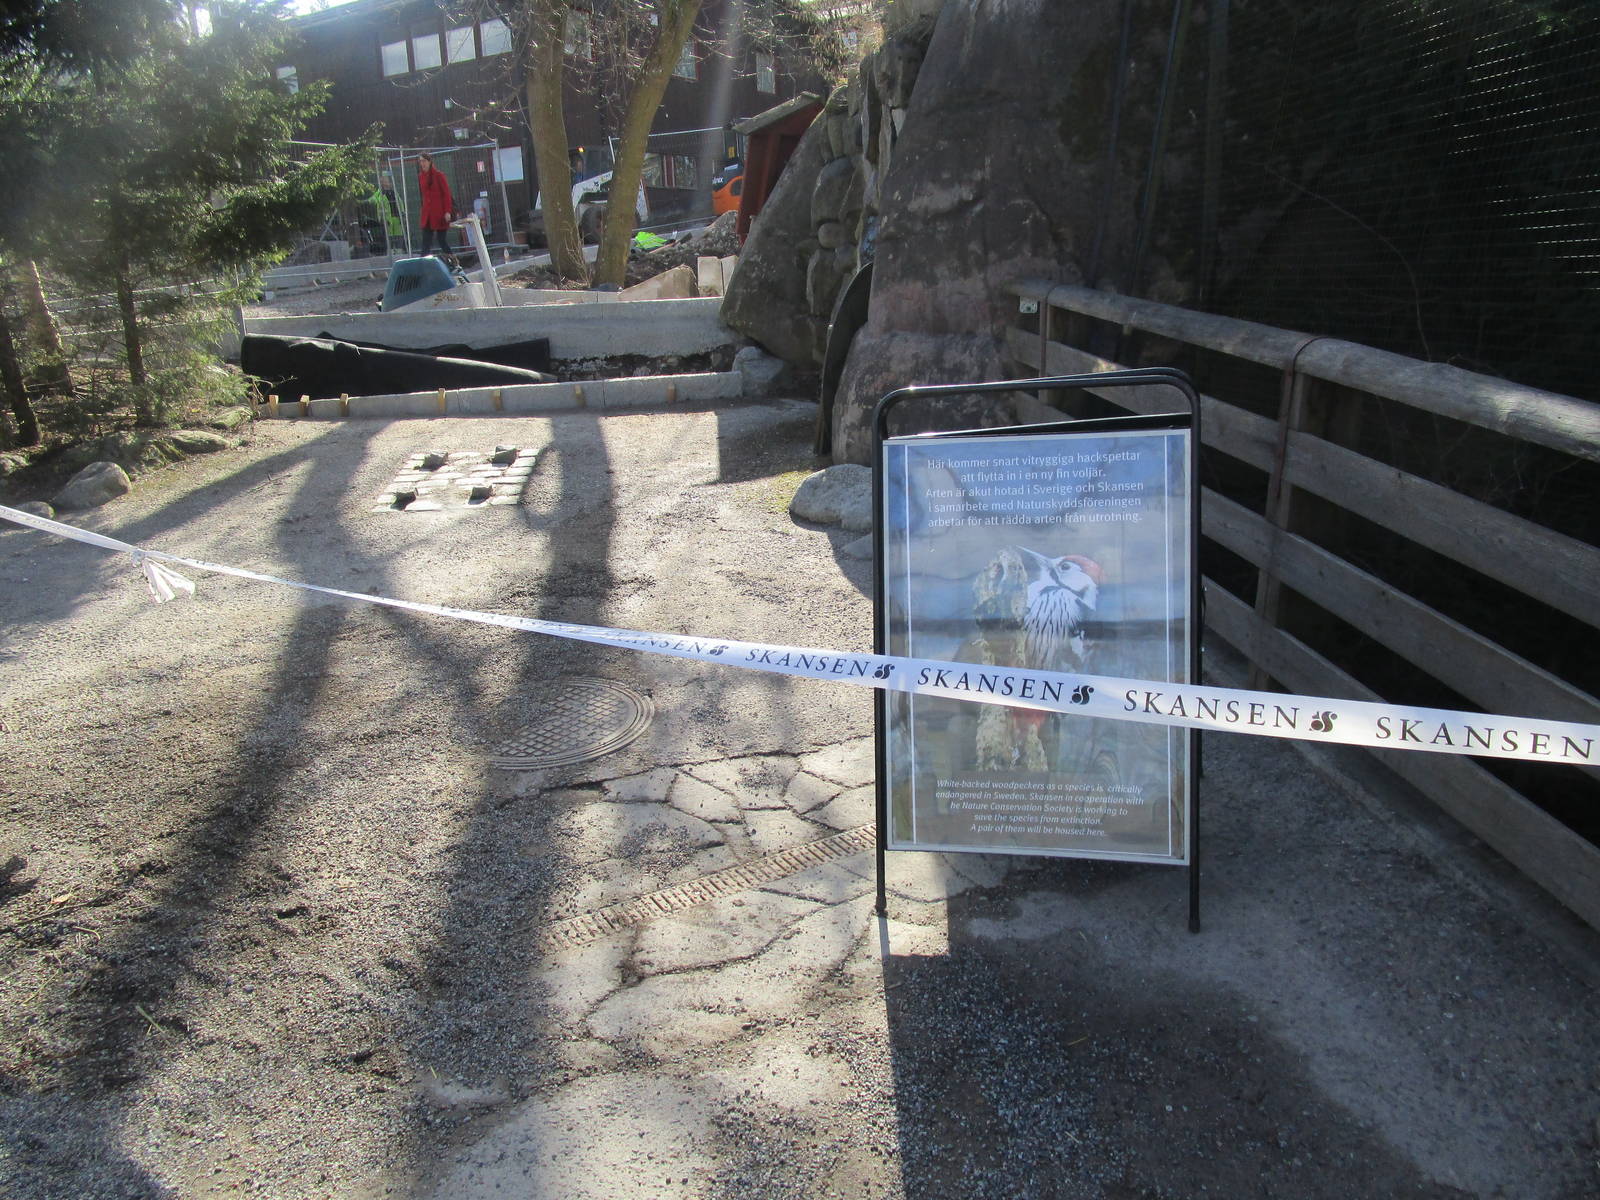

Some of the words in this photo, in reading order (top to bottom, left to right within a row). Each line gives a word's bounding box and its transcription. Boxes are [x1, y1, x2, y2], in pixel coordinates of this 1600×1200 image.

[928, 459, 945, 469] Här
[949, 458, 990, 468] kommer
[993, 457, 1019, 467] snart
[1023, 454, 1074, 466] vitryggiga
[1078, 452, 1140, 464] hackspettar
[961, 473, 974, 483] att
[978, 472, 1004, 482] flytta
[1007, 472, 1016, 480] in
[1041, 471, 1053, 481] ny
[1057, 468, 1069, 479] fin
[1073, 468, 1106, 480] voljär.
[926, 488, 953, 498] Arten
[956, 488, 965, 497] är
[969, 487, 991, 497] akut
[995, 486, 1024, 496] hotad
[1033, 484, 1072, 496] Sverige
[1076, 482, 1094, 493] och
[1098, 482, 1144, 492] Skansen
[934, 501, 989, 513] samarbete
[992, 500, 1013, 511] med
[1017, 497, 1141, 510] Naturskyddsföreningen
[928, 516, 964, 528] arbetar
[968, 516, 981, 526] för
[985, 516, 999, 526] att
[1002, 514, 1031, 525] rädda
[1035, 514, 1062, 524] arten
[1065, 512, 1085, 523] från
[1089, 510, 1142, 523] utrotning.
[605, 631, 706, 654] ANSEN
[745, 648, 872, 677] SKANSEN
[917, 667, 1064, 703] SKANSEN
[1124, 690, 1300, 730] SKANSEN
[1376, 716, 1594, 759] SKANSEN
[937, 780, 990, 789] White-backed
[992, 781, 1045, 790] woodpeckers
[1065, 784, 1095, 792] species
[1108, 784, 1143, 794] critically
[936, 791, 982, 800] endangered
[1030, 792, 1063, 801] Skansen
[1065, 794, 1073, 802] in
[1126, 796, 1144, 805] with
[962, 802, 988, 810] Nature
[990, 802, 1042, 812] Conservation
[1044, 804, 1074, 814] Society
[1084, 806, 1117, 817] working
[1120, 807, 1128, 816] to
[1009, 814, 1038, 823] species
[1040, 815, 1059, 824] from
[978, 824, 994, 833] pair
[995, 824, 1004, 834] of
[1005, 825, 1025, 833] them
[1043, 826, 1053, 834] be
[1055, 827, 1086, 836] housed
